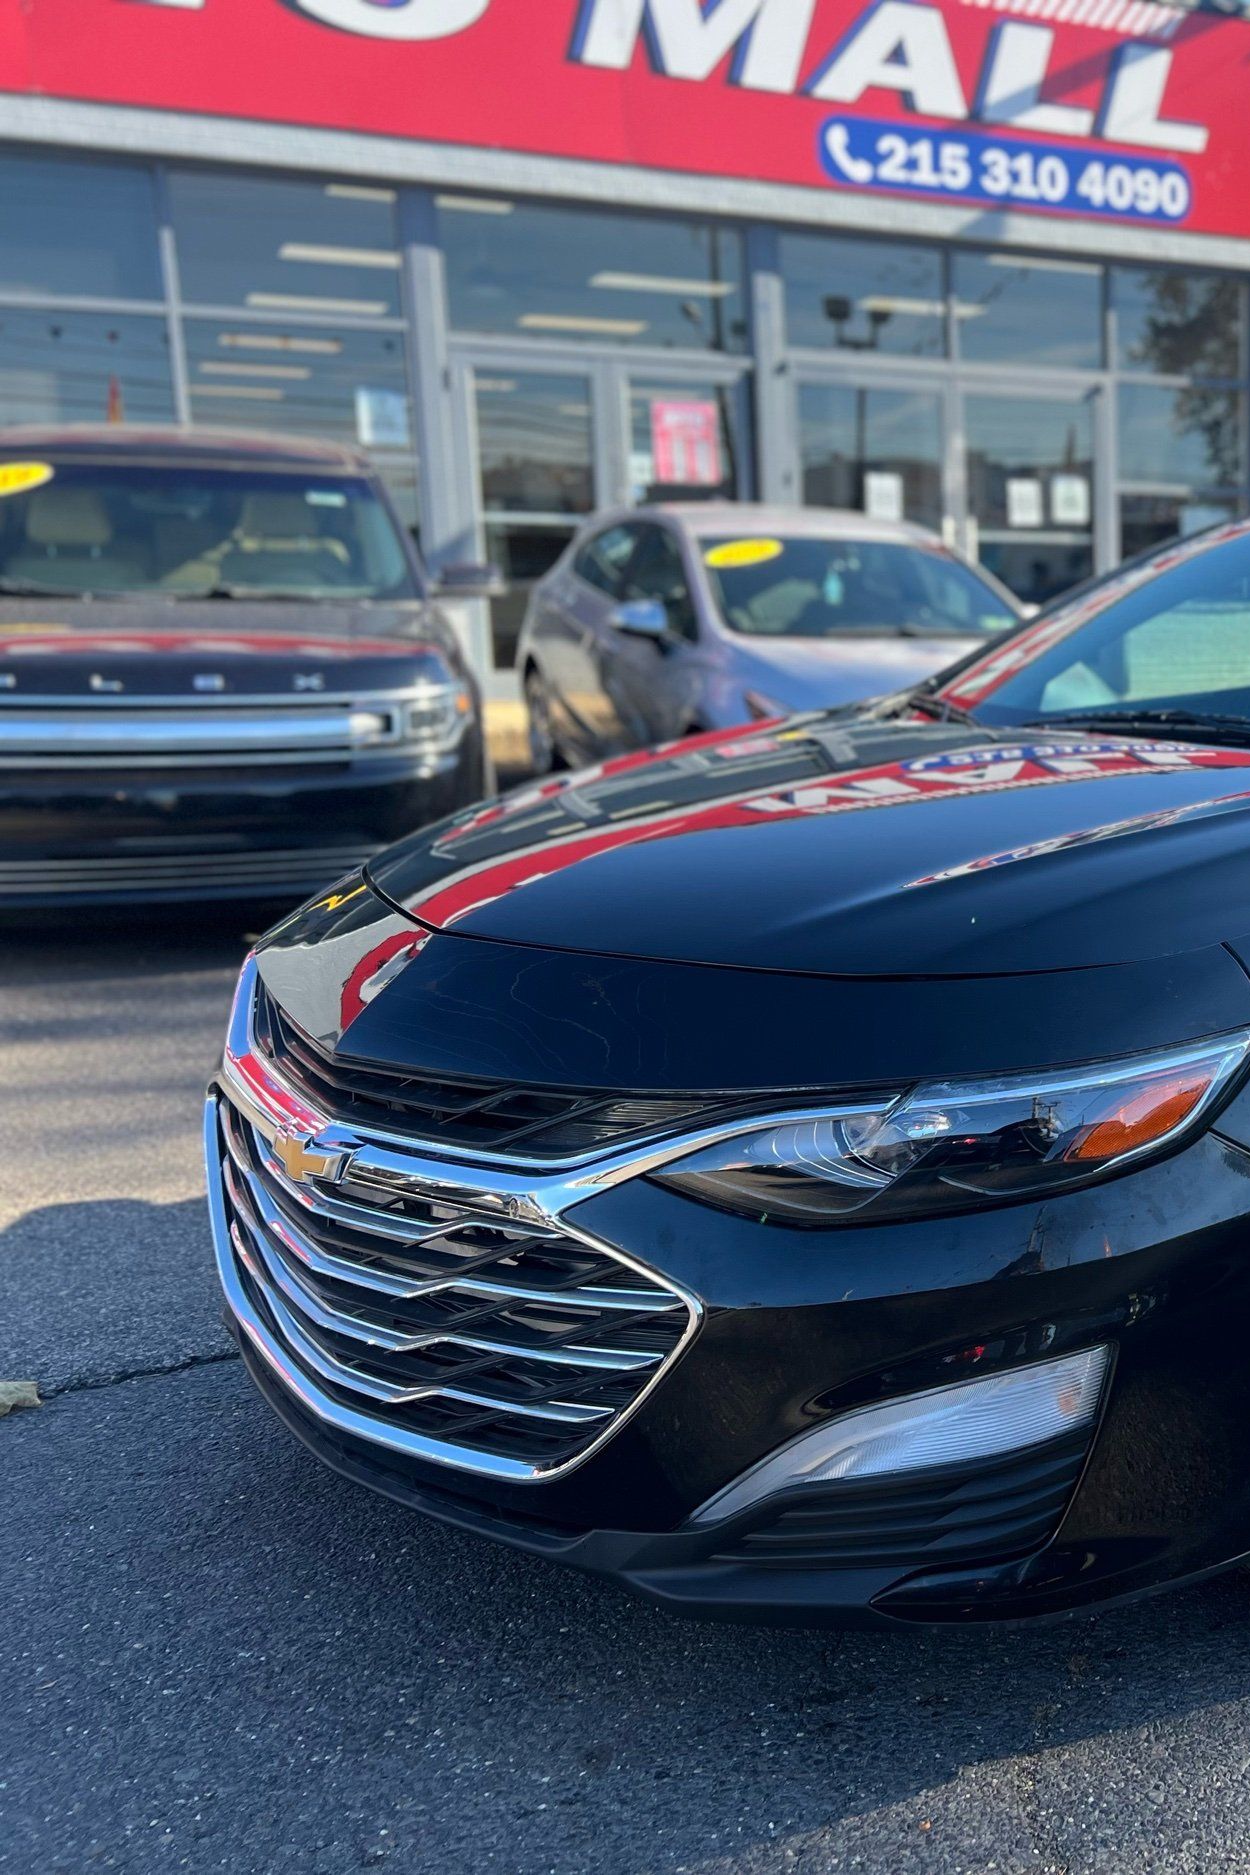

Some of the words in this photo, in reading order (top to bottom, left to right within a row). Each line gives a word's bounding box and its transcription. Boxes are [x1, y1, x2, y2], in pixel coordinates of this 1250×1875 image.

[566, 0, 1210, 153] MALL
[875, 133, 972, 191] 215
[979, 147, 1070, 203] 310
[1076, 160, 1190, 218] 4090
